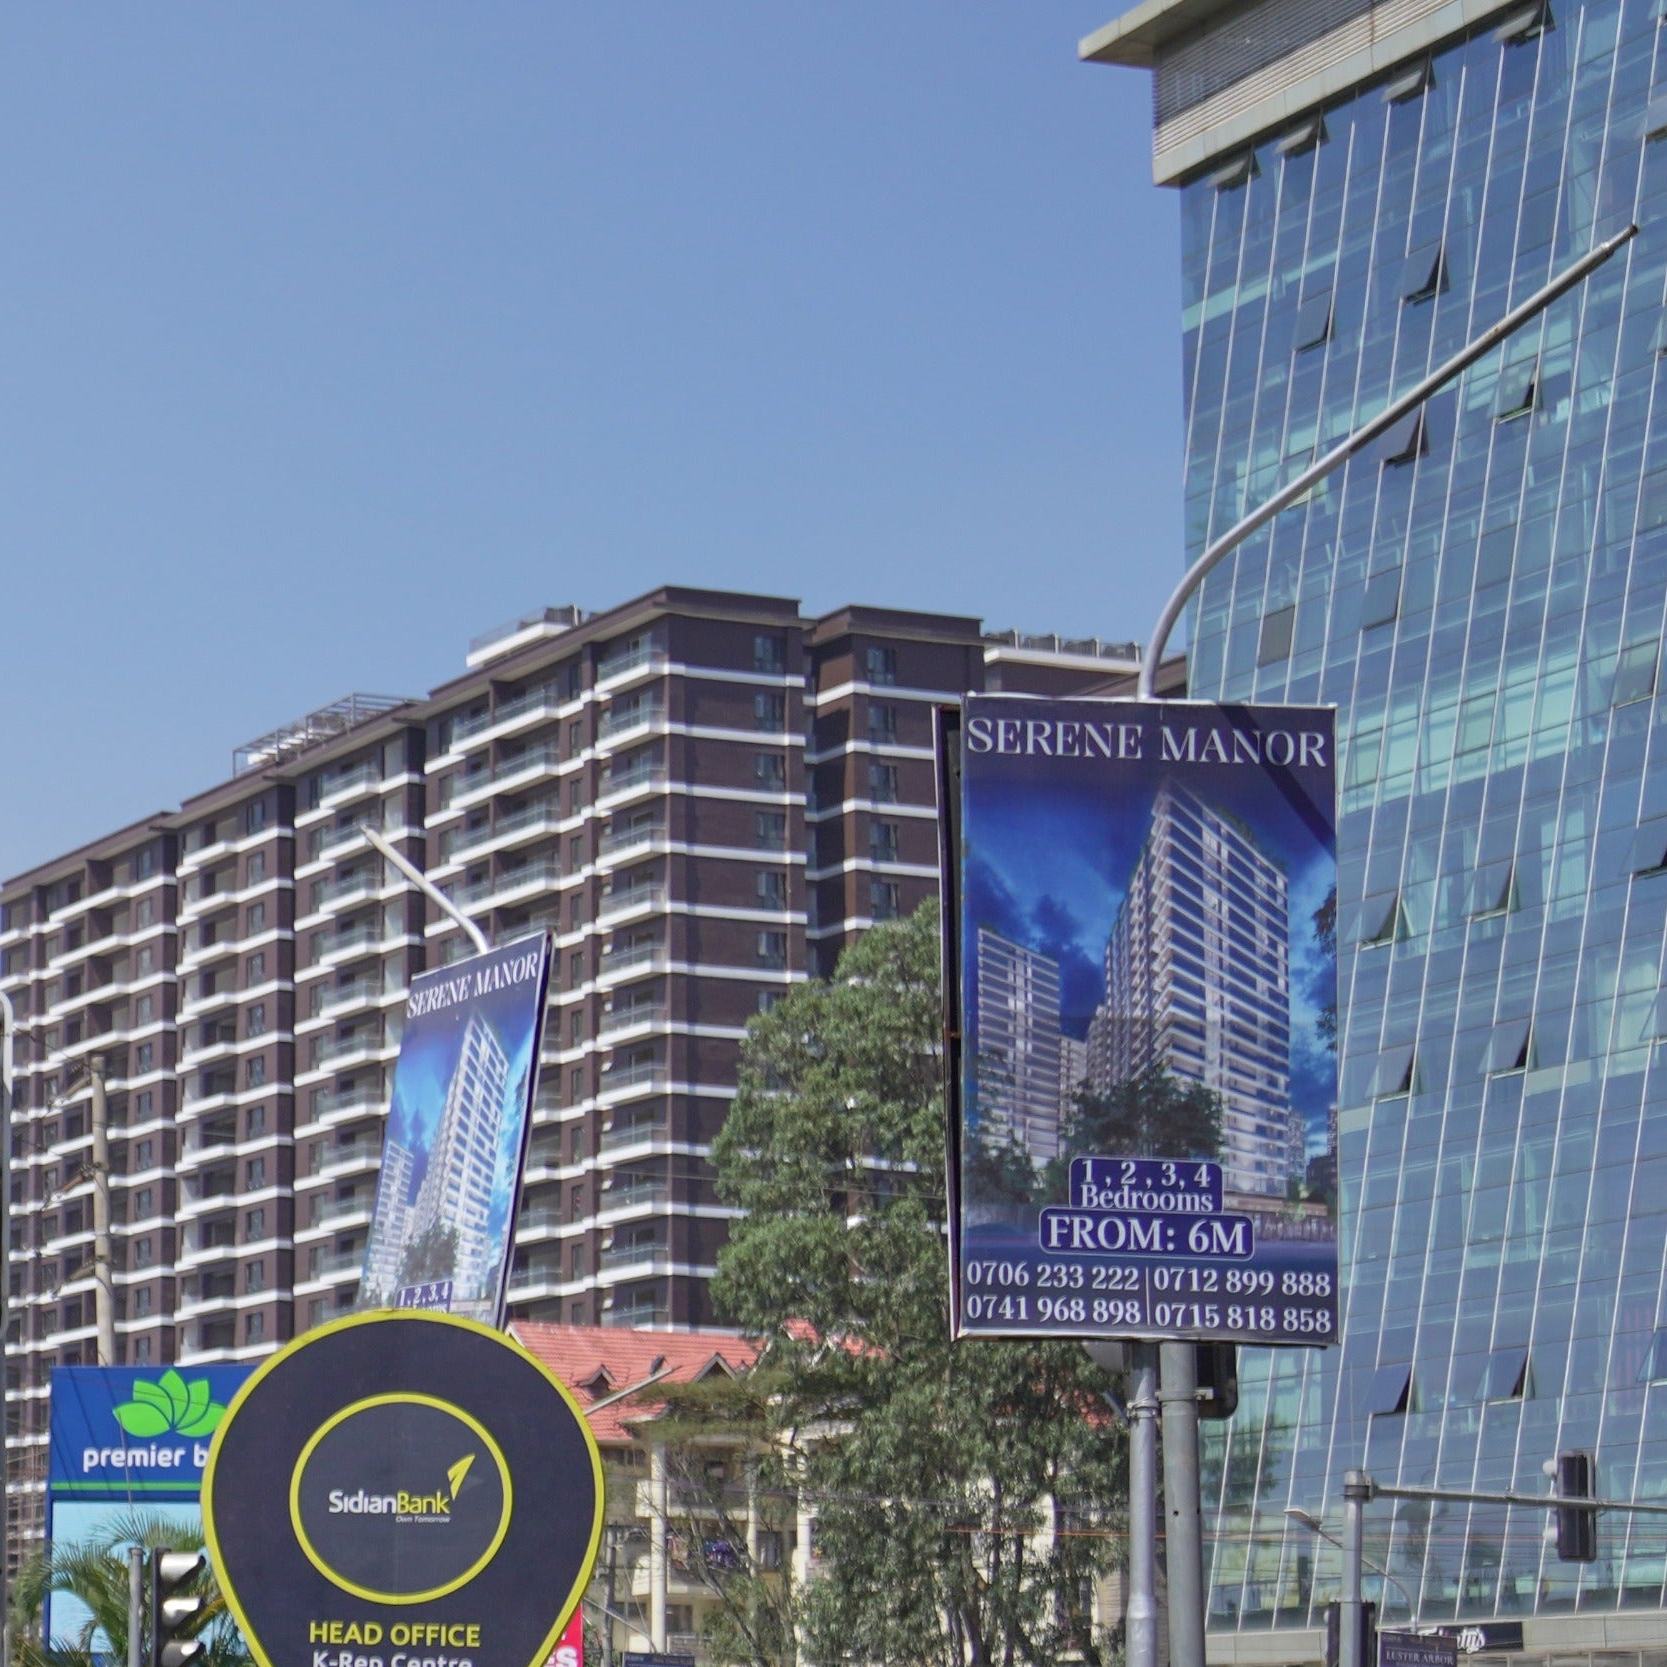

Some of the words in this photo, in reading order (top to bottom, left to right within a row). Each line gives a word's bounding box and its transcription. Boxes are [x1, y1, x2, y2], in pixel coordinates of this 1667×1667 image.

[967, 718, 1142, 760] SERENE
[1159, 725, 1327, 767] MANOR
[407, 974, 472, 1019] SERENE
[474, 951, 538, 998] MANOR
[1080, 1184, 1214, 1212] Bedrooms
[1047, 1214, 1176, 1251] FROM:
[1188, 1218, 1247, 1255] 6M
[967, 1260, 1030, 1287] 0706
[1036, 1263, 1084, 1290] 233
[1091, 1265, 1140, 1291] 222
[1153, 1267, 1219, 1293] 0712
[1225, 1269, 1275, 1296] 899
[1281, 1272, 1332, 1297] 888
[967, 1295, 1030, 1320] 0741
[1036, 1296, 1086, 1323] 968
[1092, 1299, 1142, 1325] 898
[1154, 1303, 1220, 1328] 0715
[1226, 1305, 1277, 1331] 818
[1282, 1307, 1332, 1333] 858
[82, 1442, 186, 1473] premier
[414, 1516, 451, 1524] Tomorrow
[308, 1620, 384, 1645] HEAD
[390, 1622, 481, 1648] OFFICE
